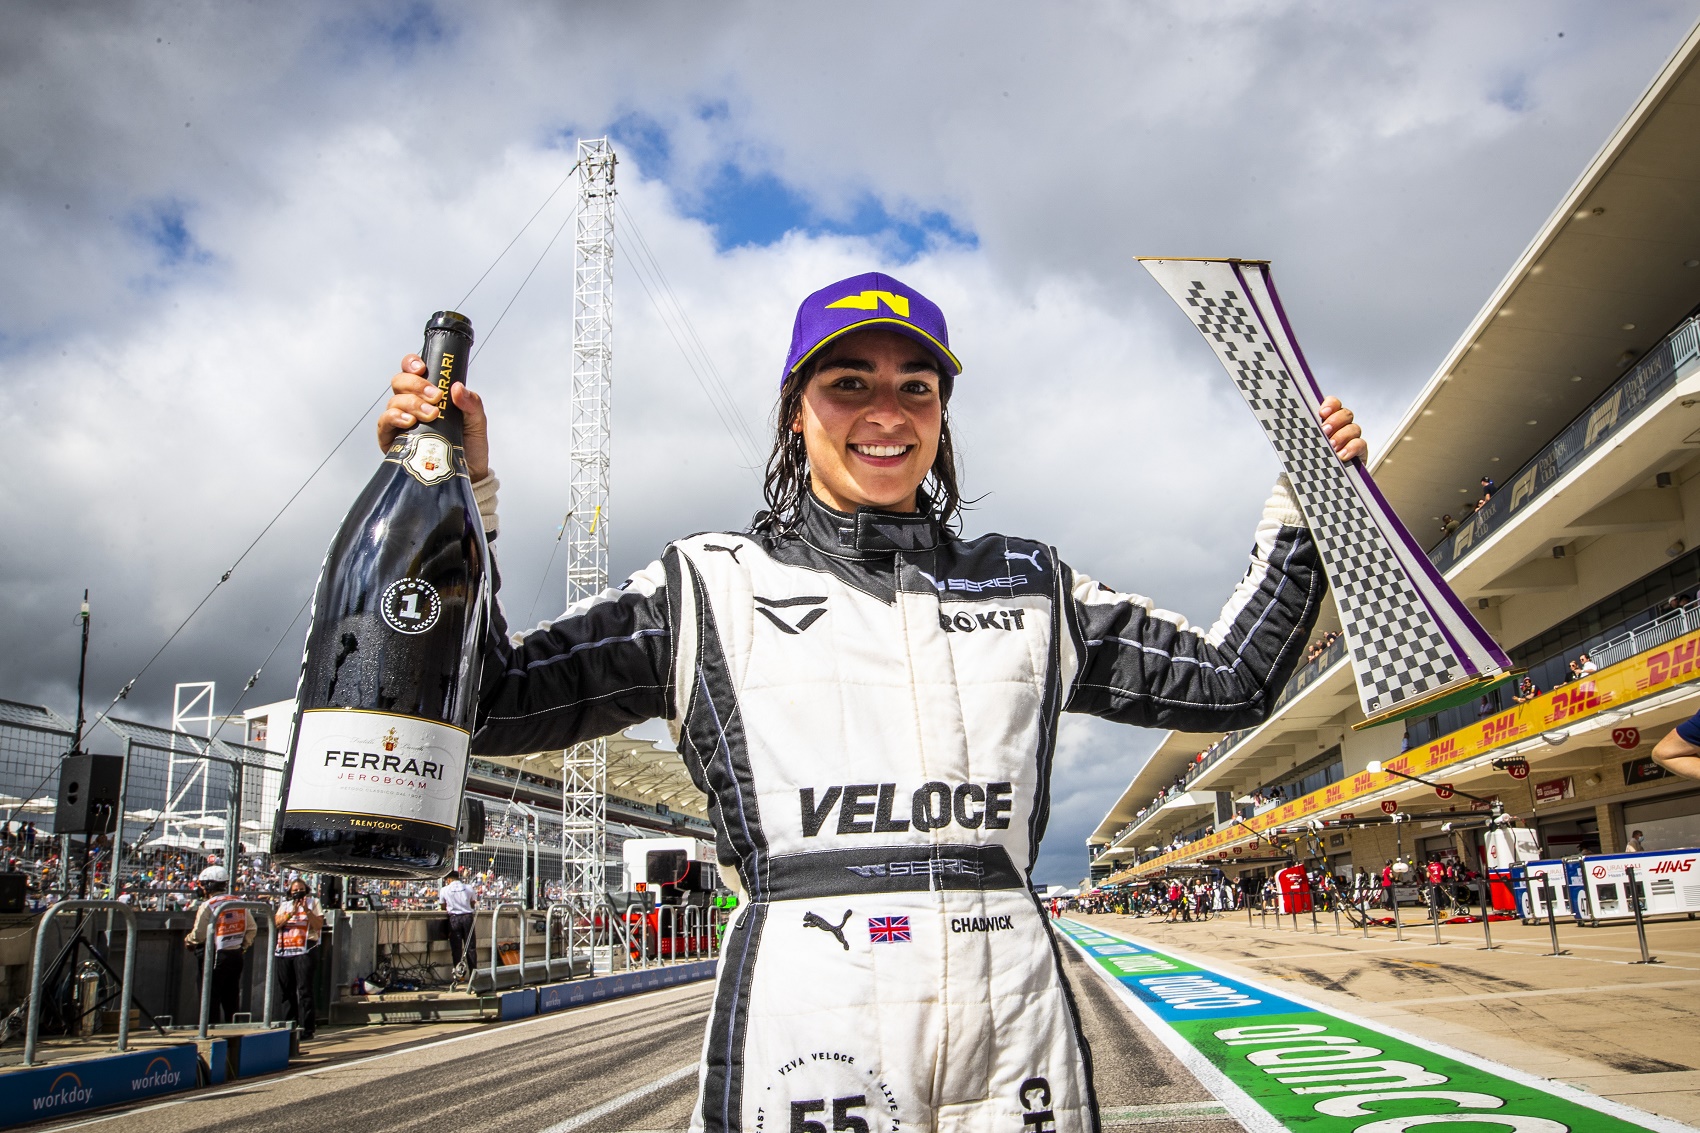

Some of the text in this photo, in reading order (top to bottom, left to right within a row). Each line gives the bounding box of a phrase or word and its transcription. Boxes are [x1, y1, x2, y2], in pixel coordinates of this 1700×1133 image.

[947, 575, 1028, 593] SERIES
[399, 593, 422, 620] 1
[1646, 636, 1700, 687] DH
[1552, 680, 1601, 722] DHL
[1482, 713, 1520, 747] DHL
[1615, 730, 1636, 745] 29
[1429, 738, 1459, 766] DHL
[324, 750, 445, 781] FERRARI
[1387, 757, 1411, 780] DHL
[337, 772, 428, 790] JEROBOAM
[1354, 773, 1373, 792] DHL
[799, 781, 1013, 838] VELOCE
[1384, 802, 1394, 812] 26
[350, 818, 404, 831] TRENTODOC
[1649, 859, 1697, 874] HAAS
[951, 915, 1014, 934] CHADWICK
[778, 1052, 855, 1076] VIVA VELOCE
[132, 1071, 181, 1091] workday
[33, 1087, 93, 1111] workday
[880, 1084, 898, 1112] LIVE
[756, 1107, 765, 1133] AST
[790, 1094, 870, 1133] 55
